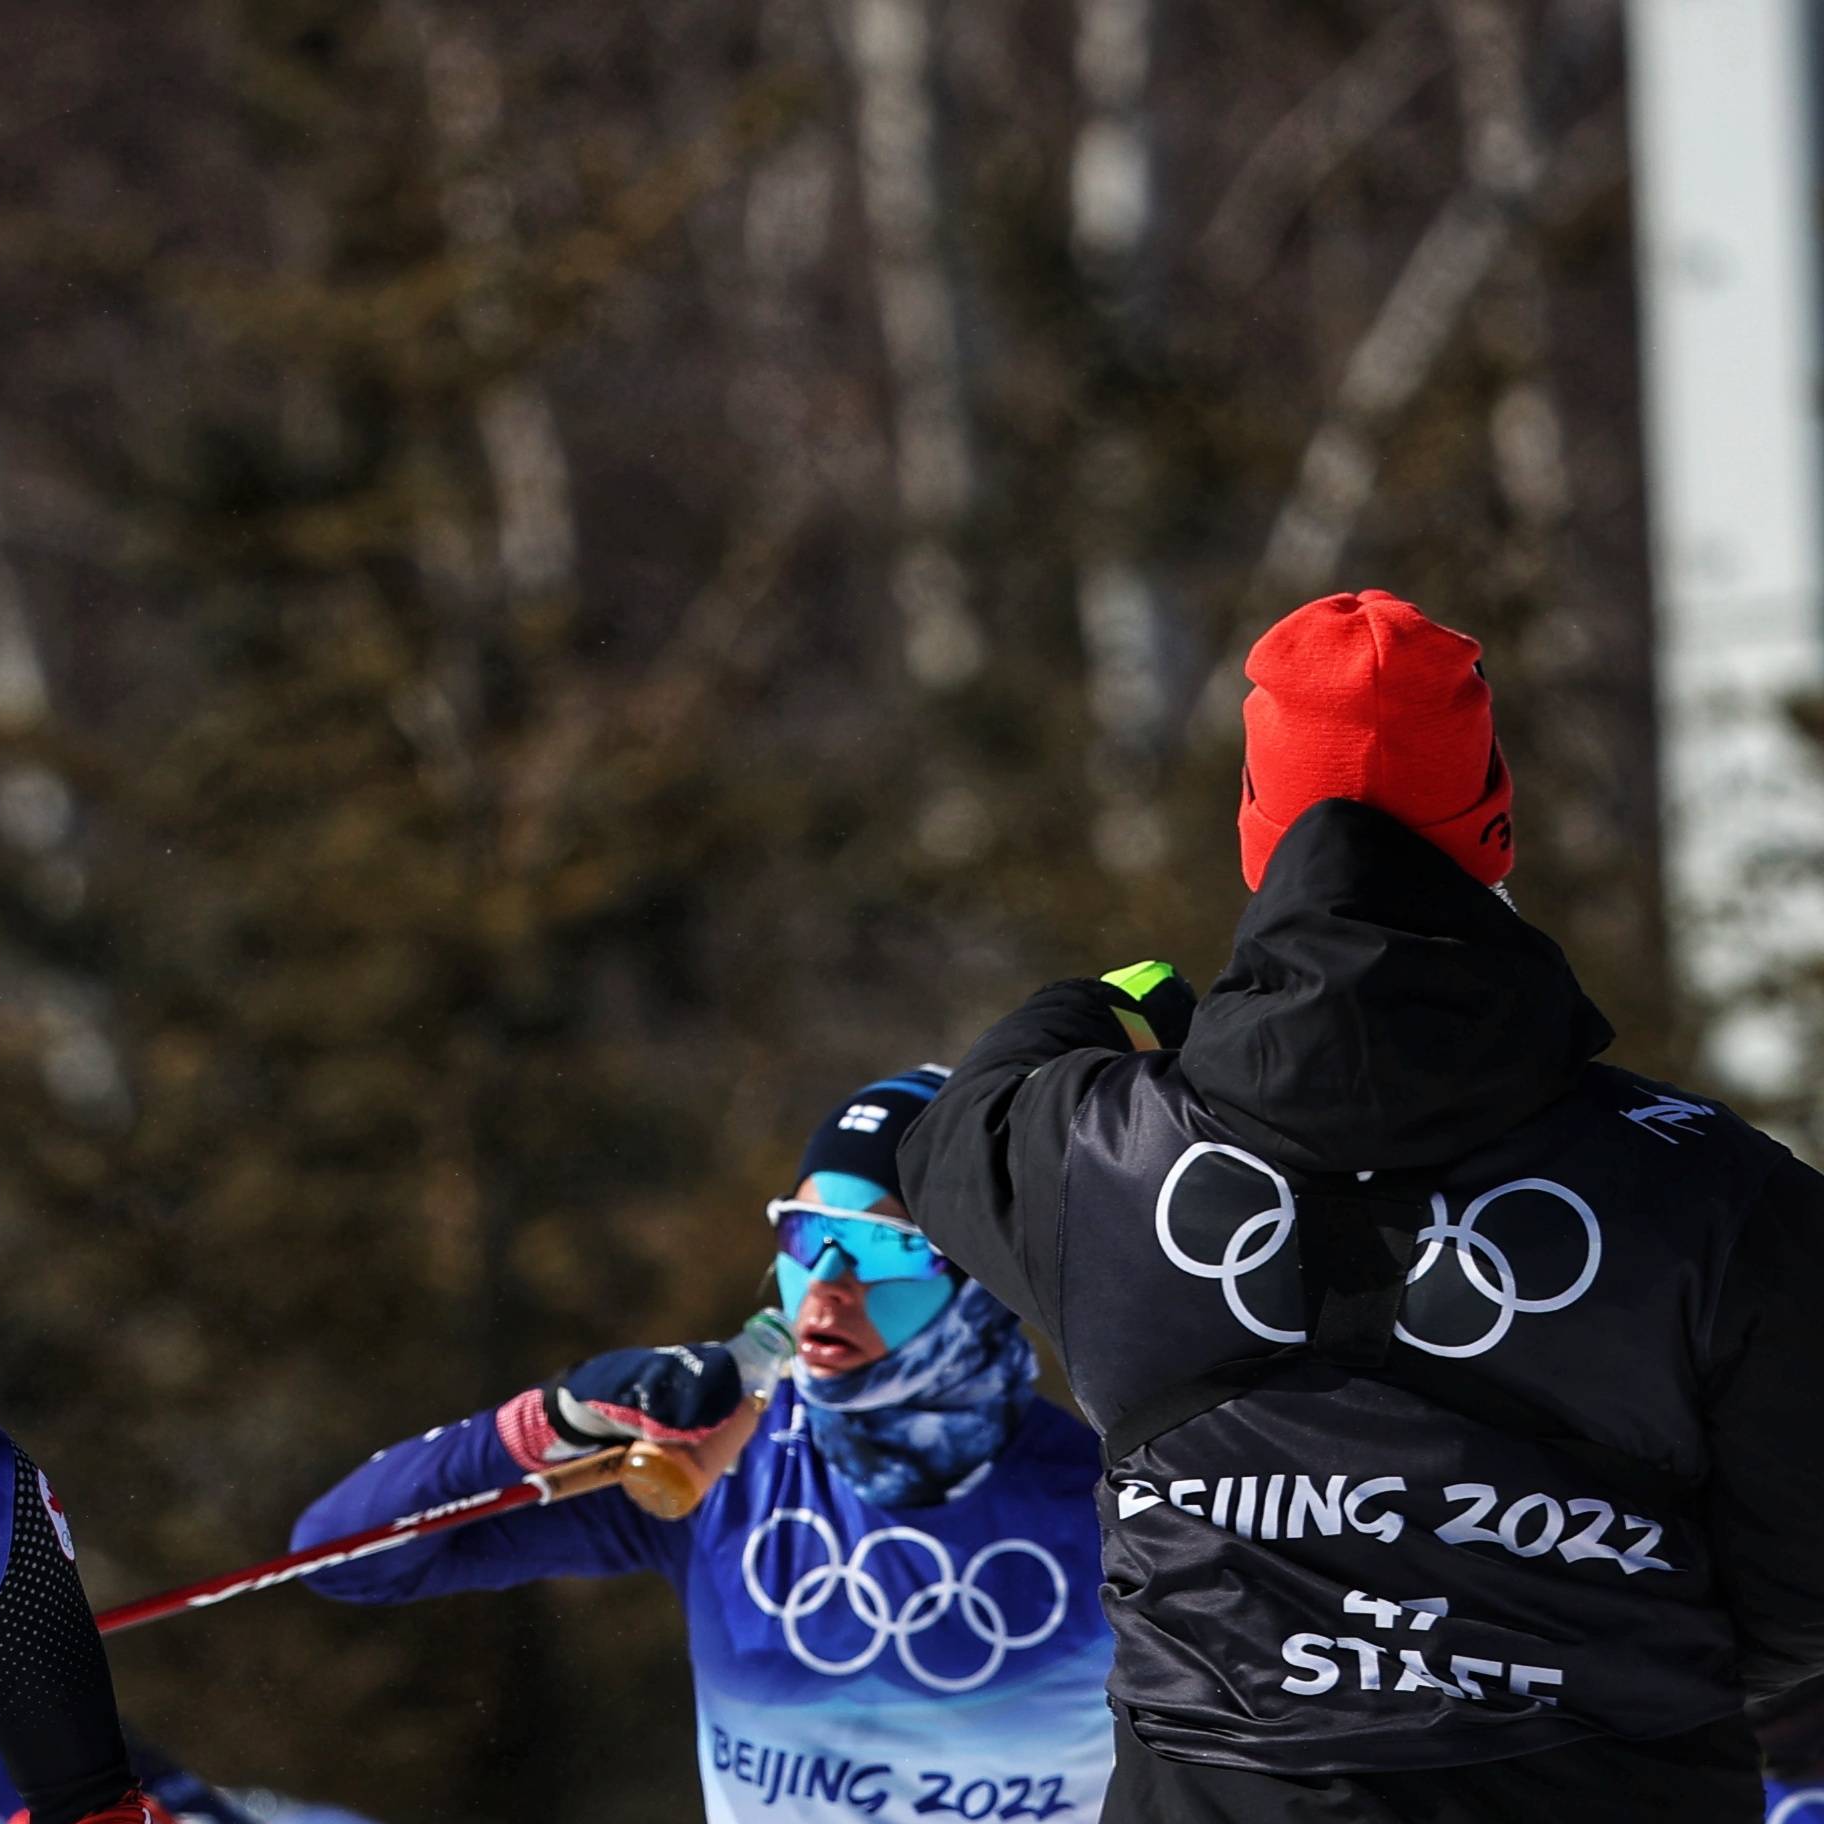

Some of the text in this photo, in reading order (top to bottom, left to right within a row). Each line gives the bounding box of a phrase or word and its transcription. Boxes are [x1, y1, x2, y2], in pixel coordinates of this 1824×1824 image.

[1434, 1483, 1679, 1575] 2022
[712, 1725, 1075, 1821] BEIJING 2022
